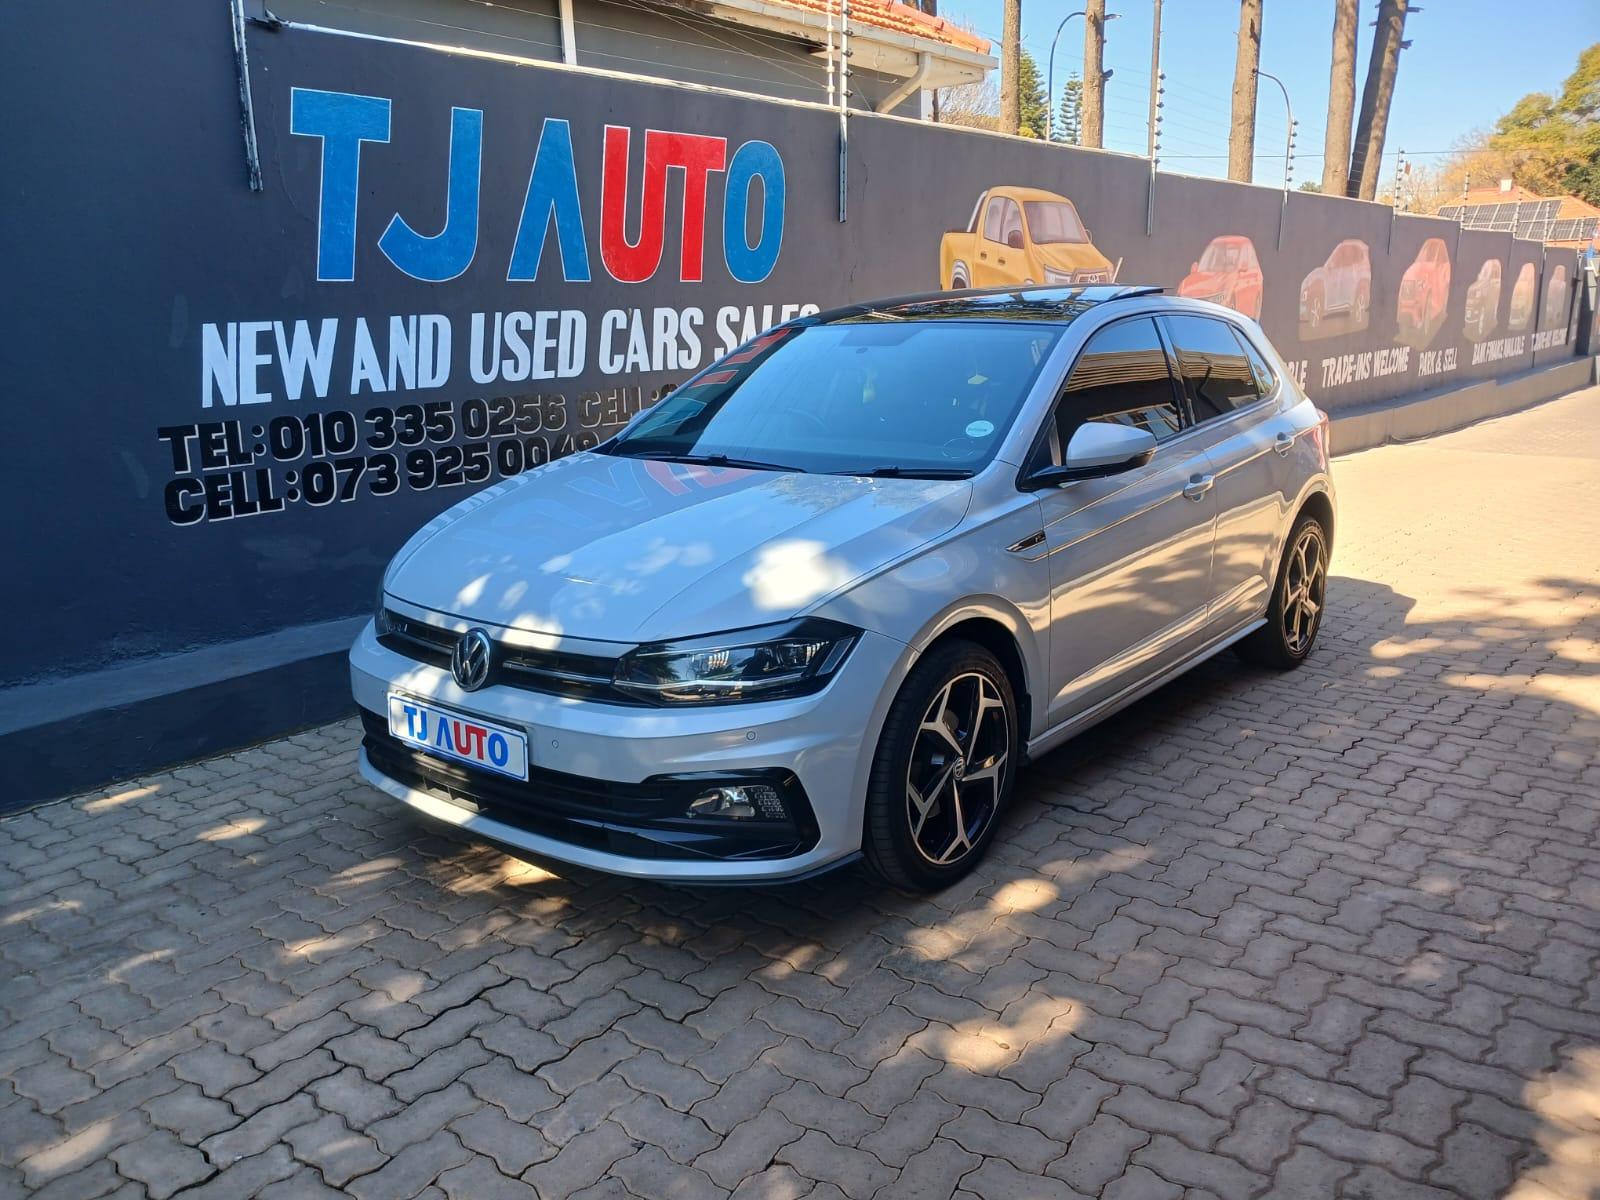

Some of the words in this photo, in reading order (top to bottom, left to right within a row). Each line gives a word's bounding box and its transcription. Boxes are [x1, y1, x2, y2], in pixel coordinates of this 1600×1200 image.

[290, 87, 483, 282] TJ
[507, 118, 785, 284] AUTO
[202, 318, 338, 408] NEW
[350, 314, 451, 395] AND
[470, 309, 586, 384] USED
[599, 307, 703, 375] CARS
[1321, 352, 1372, 389] TRADE-INS
[1374, 346, 1410, 378] WELCOME
[1418, 350, 1437, 377] PARK
[1443, 347, 1457, 371] SELL
[364, 401, 455, 451] 335
[461, 393, 567, 440] 0256
[406, 441, 492, 491] 925
[404, 705, 427, 741] TJ
[436, 716, 509, 767] AUTO
